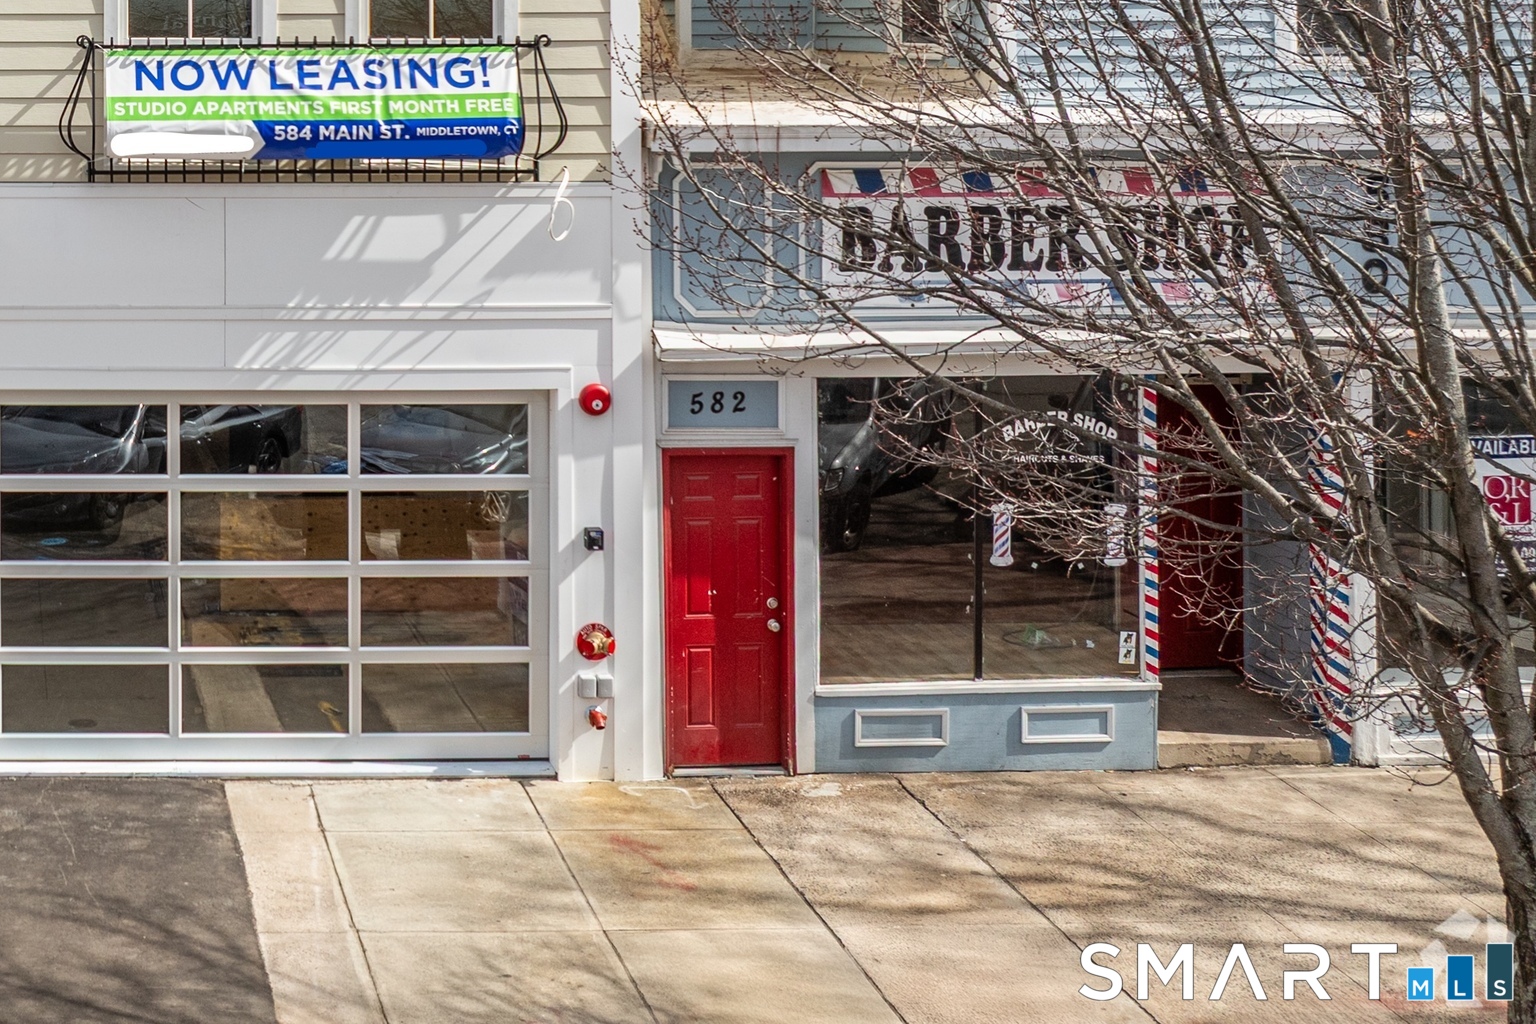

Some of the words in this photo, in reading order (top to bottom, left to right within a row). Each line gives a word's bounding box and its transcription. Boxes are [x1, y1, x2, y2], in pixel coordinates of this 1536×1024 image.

[134, 59, 257, 91] NOW
[269, 56, 491, 91] LEASING!
[113, 101, 187, 116] STUDIO
[192, 100, 324, 116] APARTMENTS
[330, 100, 382, 115] FIRST
[388, 99, 460, 114] MONTH
[465, 97, 515, 112] FREE
[273, 125, 312, 141] 584
[318, 124, 373, 141] MAIN
[378, 124, 411, 140] ST.
[415, 125, 501, 137] MIDDLETOWN,
[503, 122, 520, 135] CT
[838, 205, 1087, 273] BARBER
[690, 390, 747, 415] 582
[1001, 410, 1069, 442] BARER
[1472, 439, 1536, 455] VAILABL
